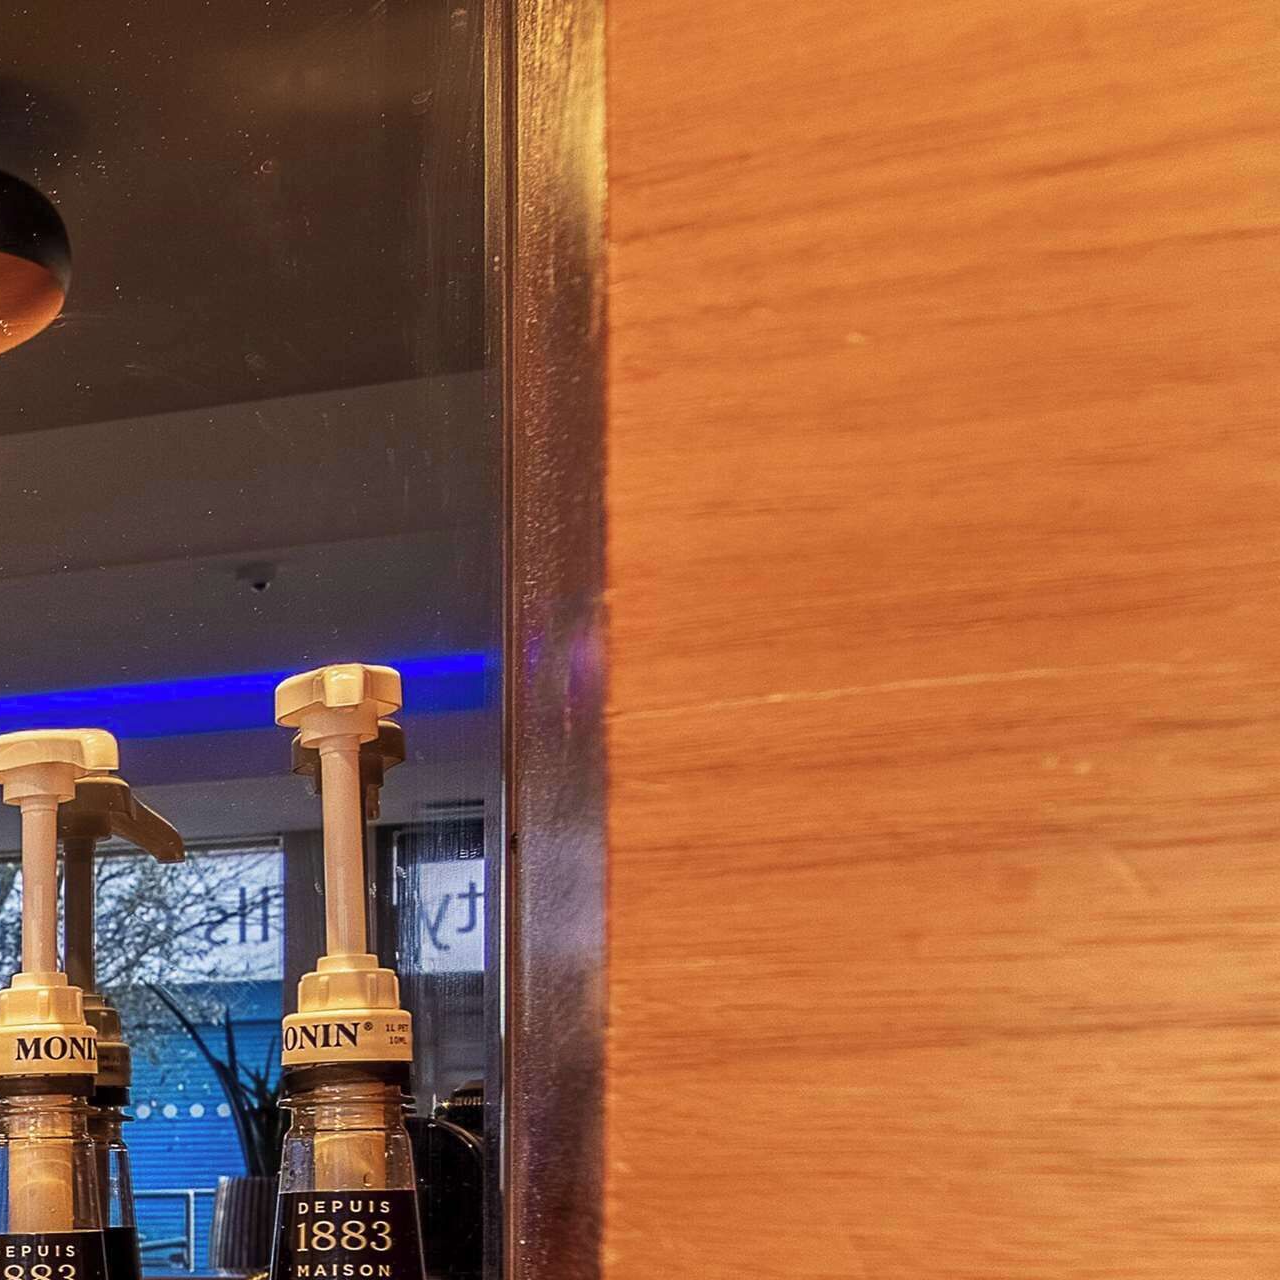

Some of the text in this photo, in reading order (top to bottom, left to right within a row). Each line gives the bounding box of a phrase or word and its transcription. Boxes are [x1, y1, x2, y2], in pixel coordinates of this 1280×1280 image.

[283, 1021, 361, 1051] ONIN
[298, 1200, 390, 1214] DEPUIS
[297, 1221, 392, 1251] 1883
[298, 1264, 390, 1277] MAISON
